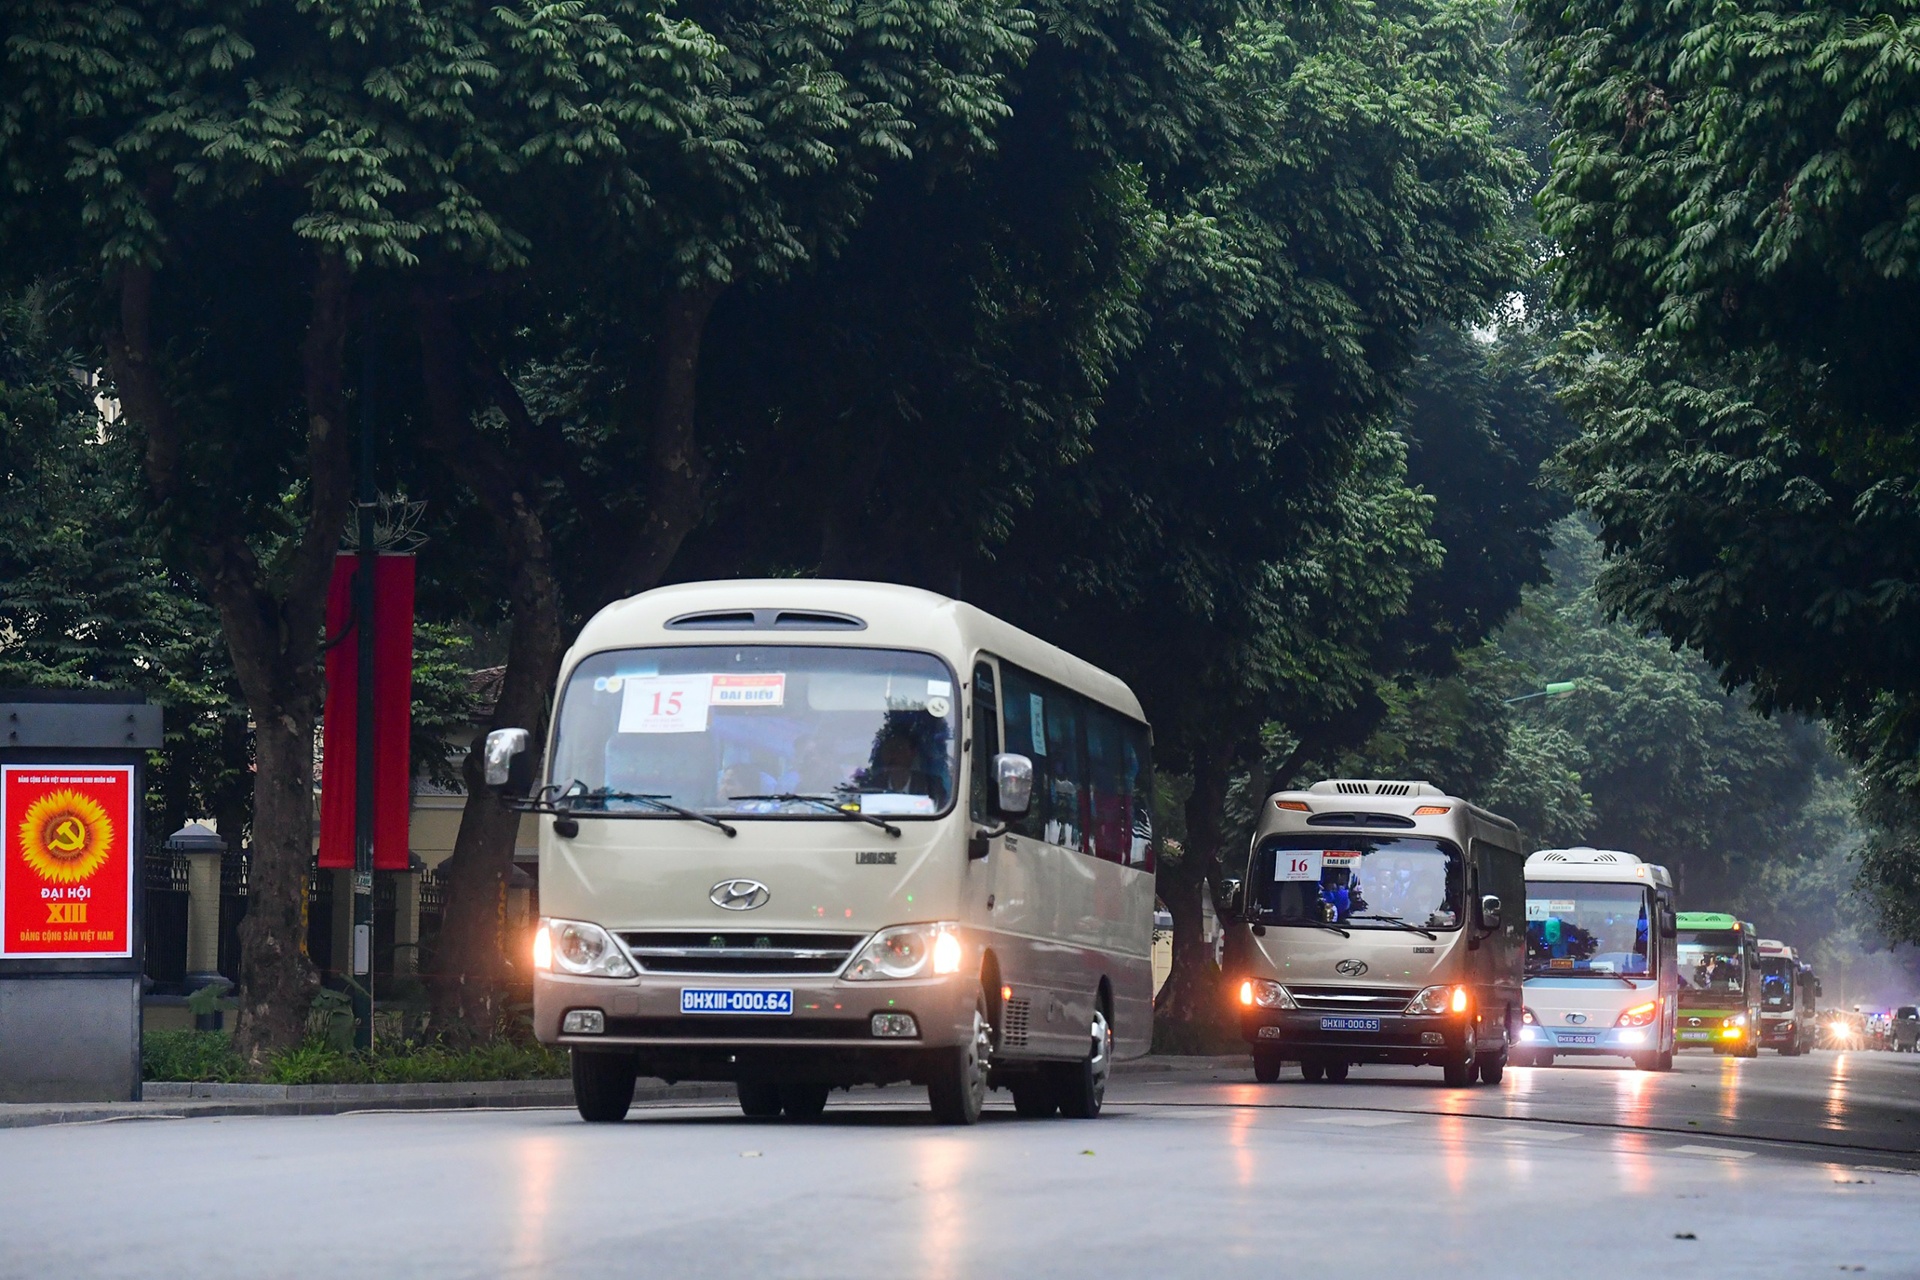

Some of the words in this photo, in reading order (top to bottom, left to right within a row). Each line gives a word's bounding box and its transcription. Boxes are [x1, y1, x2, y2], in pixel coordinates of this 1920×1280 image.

[649, 691, 684, 716] 15
[1289, 858, 1309, 873] 16
[41, 887, 64, 901] ĐẠI
[67, 884, 91, 901] HỘI
[46, 902, 88, 923] XIII
[20, 929, 40, 941] ĐẢNG
[42, 930, 61, 943] CỘNG
[64, 928, 79, 941] SẢN
[80, 929, 95, 943] VIỆT
[97, 930, 114, 941] NAM
[684, 992, 788, 1010] ĐHXIII-000.64
